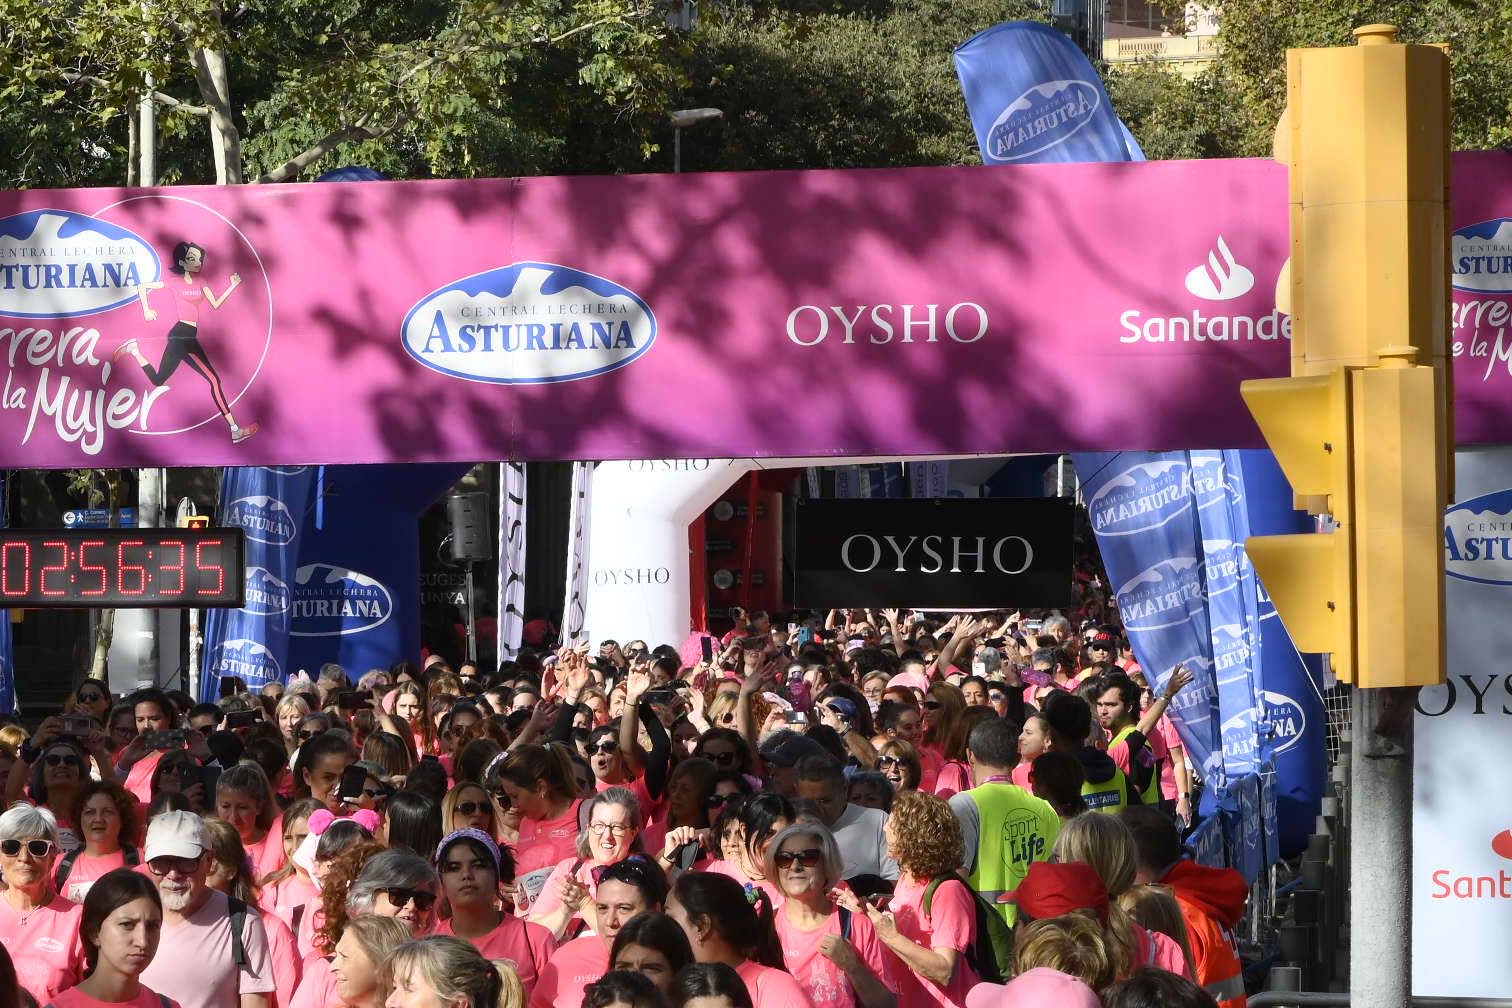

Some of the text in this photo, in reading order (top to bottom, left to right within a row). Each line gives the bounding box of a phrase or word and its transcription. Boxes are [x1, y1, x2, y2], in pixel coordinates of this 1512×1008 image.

[64, 246, 136, 259] LECHERA
[461, 303, 629, 317] CENTRAL LECHERA
[787, 302, 989, 346] OYSHO
[1119, 309, 1293, 344] Santande
[421, 309, 636, 354] ASTURIANA
[1452, 329, 1488, 357] e la
[1, 372, 27, 409] la
[22, 361, 170, 455] Mujer
[2, 541, 223, 596] 02:56:35
[841, 534, 1034, 575] OYSHO
[594, 567, 670, 585] OYSHO
[290, 599, 383, 618] TURIANA
[1004, 816, 1039, 842] Sport
[1010, 833, 1045, 865] Life
